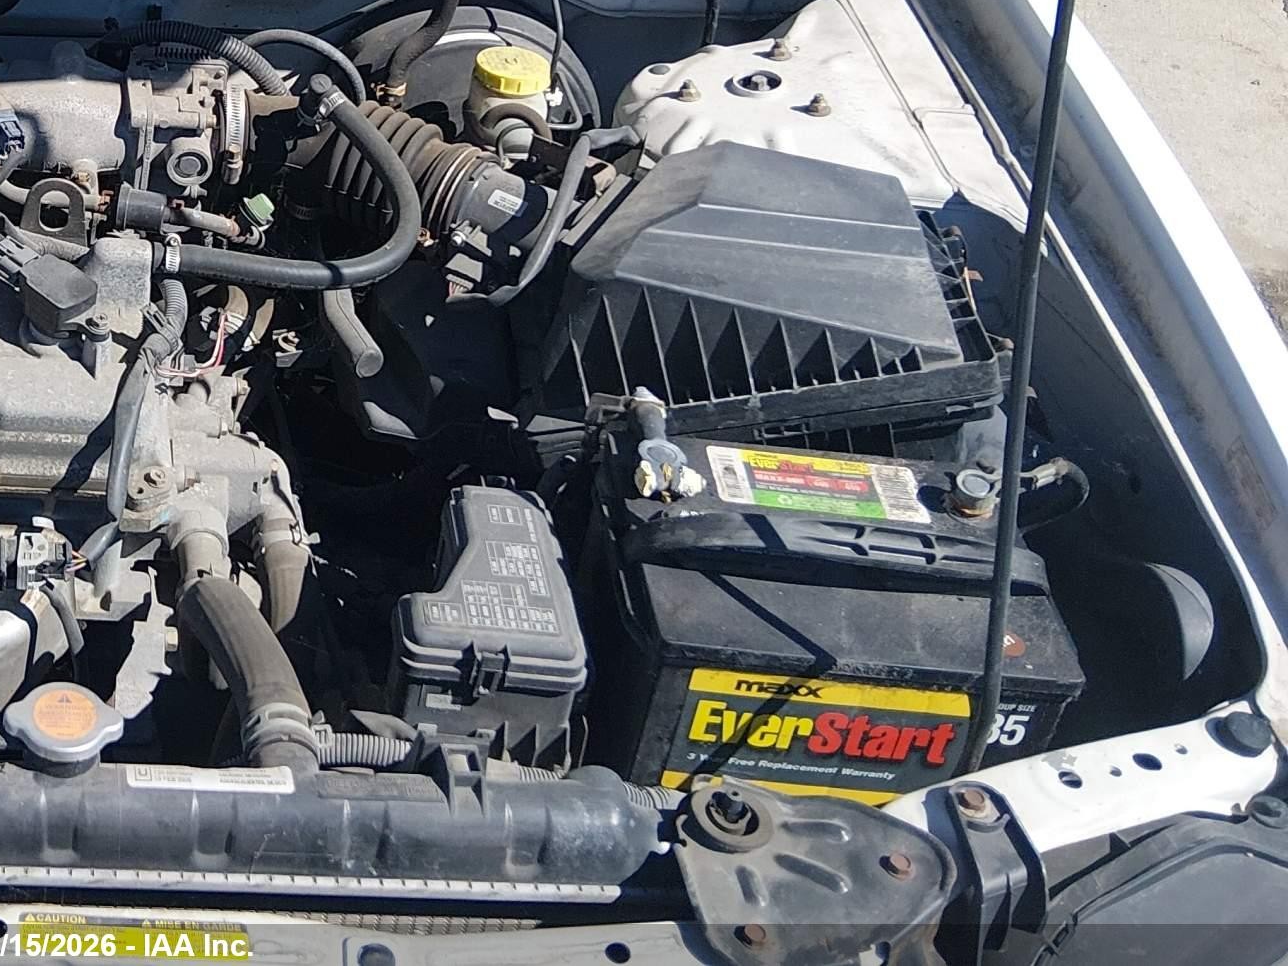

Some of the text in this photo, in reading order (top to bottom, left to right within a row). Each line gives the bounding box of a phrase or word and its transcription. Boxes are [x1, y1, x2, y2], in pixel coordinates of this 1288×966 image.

[735, 679, 823, 698] maxx
[689, 700, 954, 766] EverStart
[687, 753, 697, 761] 3
[729, 758, 755, 766] Free
[758, 760, 838, 774] Replacement
[841, 768, 895, 780] Warranty
[37, 915, 86, 924] CAUTION
[155, 921, 242, 931] MISE EN GARDE
